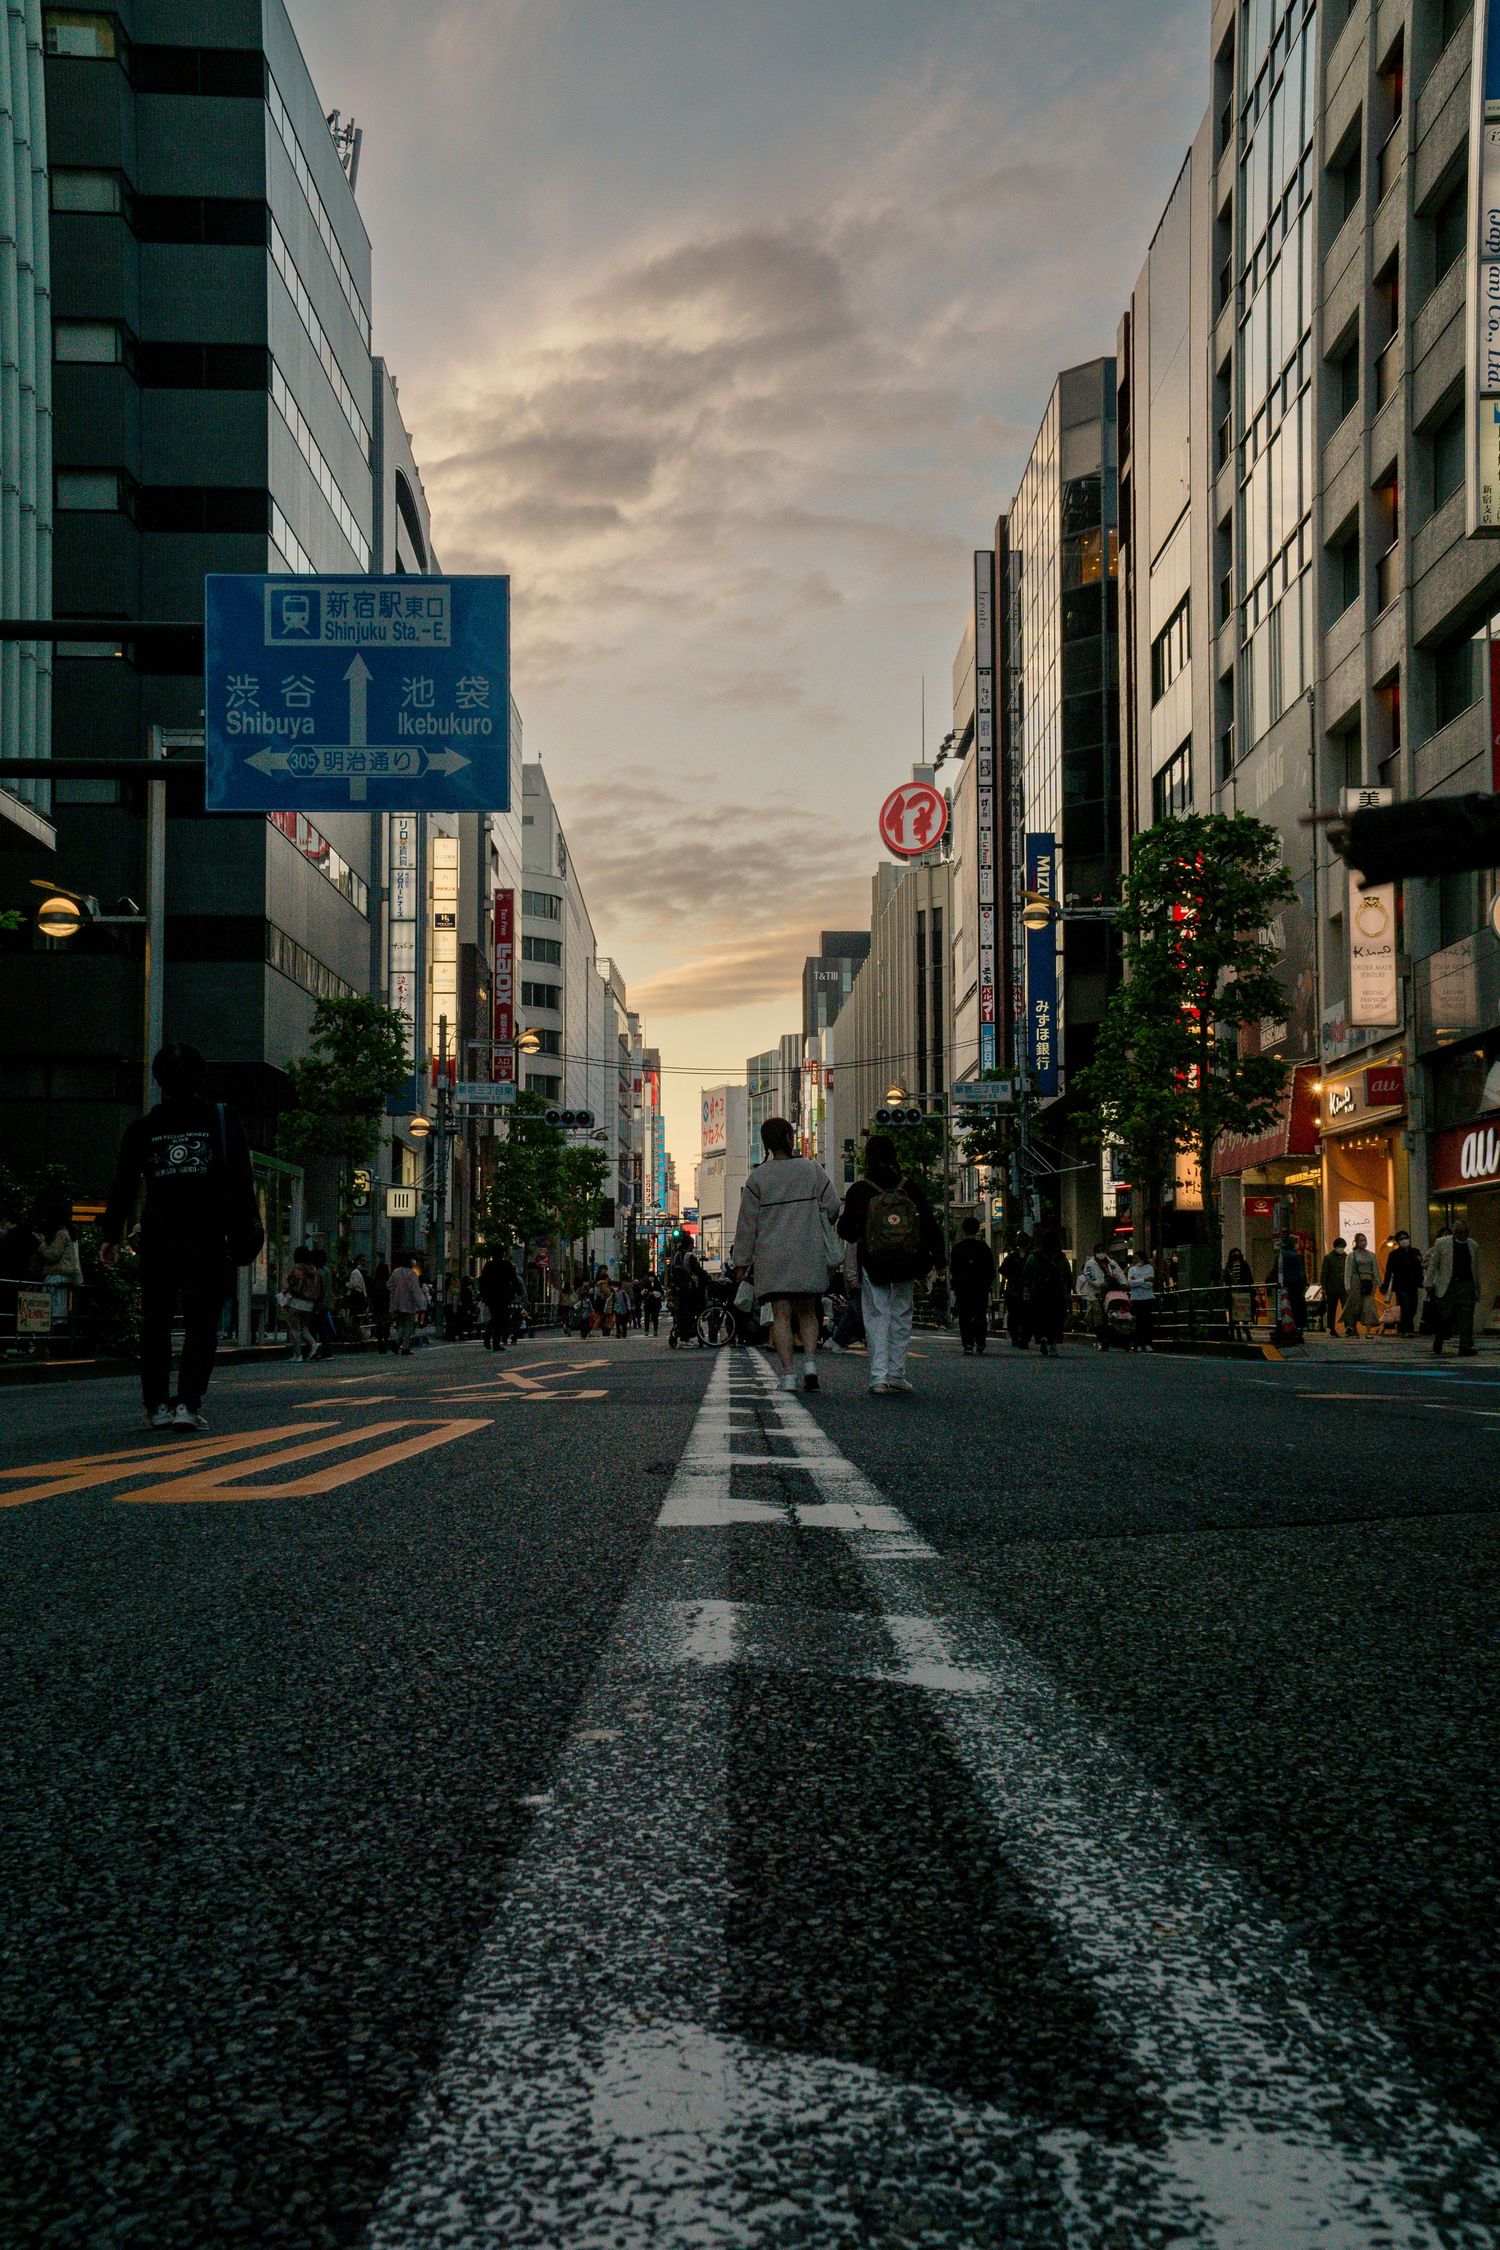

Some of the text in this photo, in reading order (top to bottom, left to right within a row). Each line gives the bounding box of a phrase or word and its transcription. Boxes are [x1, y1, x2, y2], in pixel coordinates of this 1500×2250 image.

[1482, 484, 1493, 525] 新宿支店
[325, 591, 444, 619] 新宿駅東口
[324, 624, 387, 644] Shinjuku
[225, 673, 316, 708] 渋谷
[401, 675, 491, 709] 池袋
[226, 711, 316, 739] Shibuya
[397, 712, 493, 736] Ikebukuro
[291, 750, 413, 773] 305 明治通り
[1359, 791, 1380, 808] 美
[497, 943, 512, 1005] Laox
[1035, 1001, 1050, 1070] みずほ銀行
[1371, 1080, 1398, 1092] au
[1460, 1127, 1500, 1179] au
